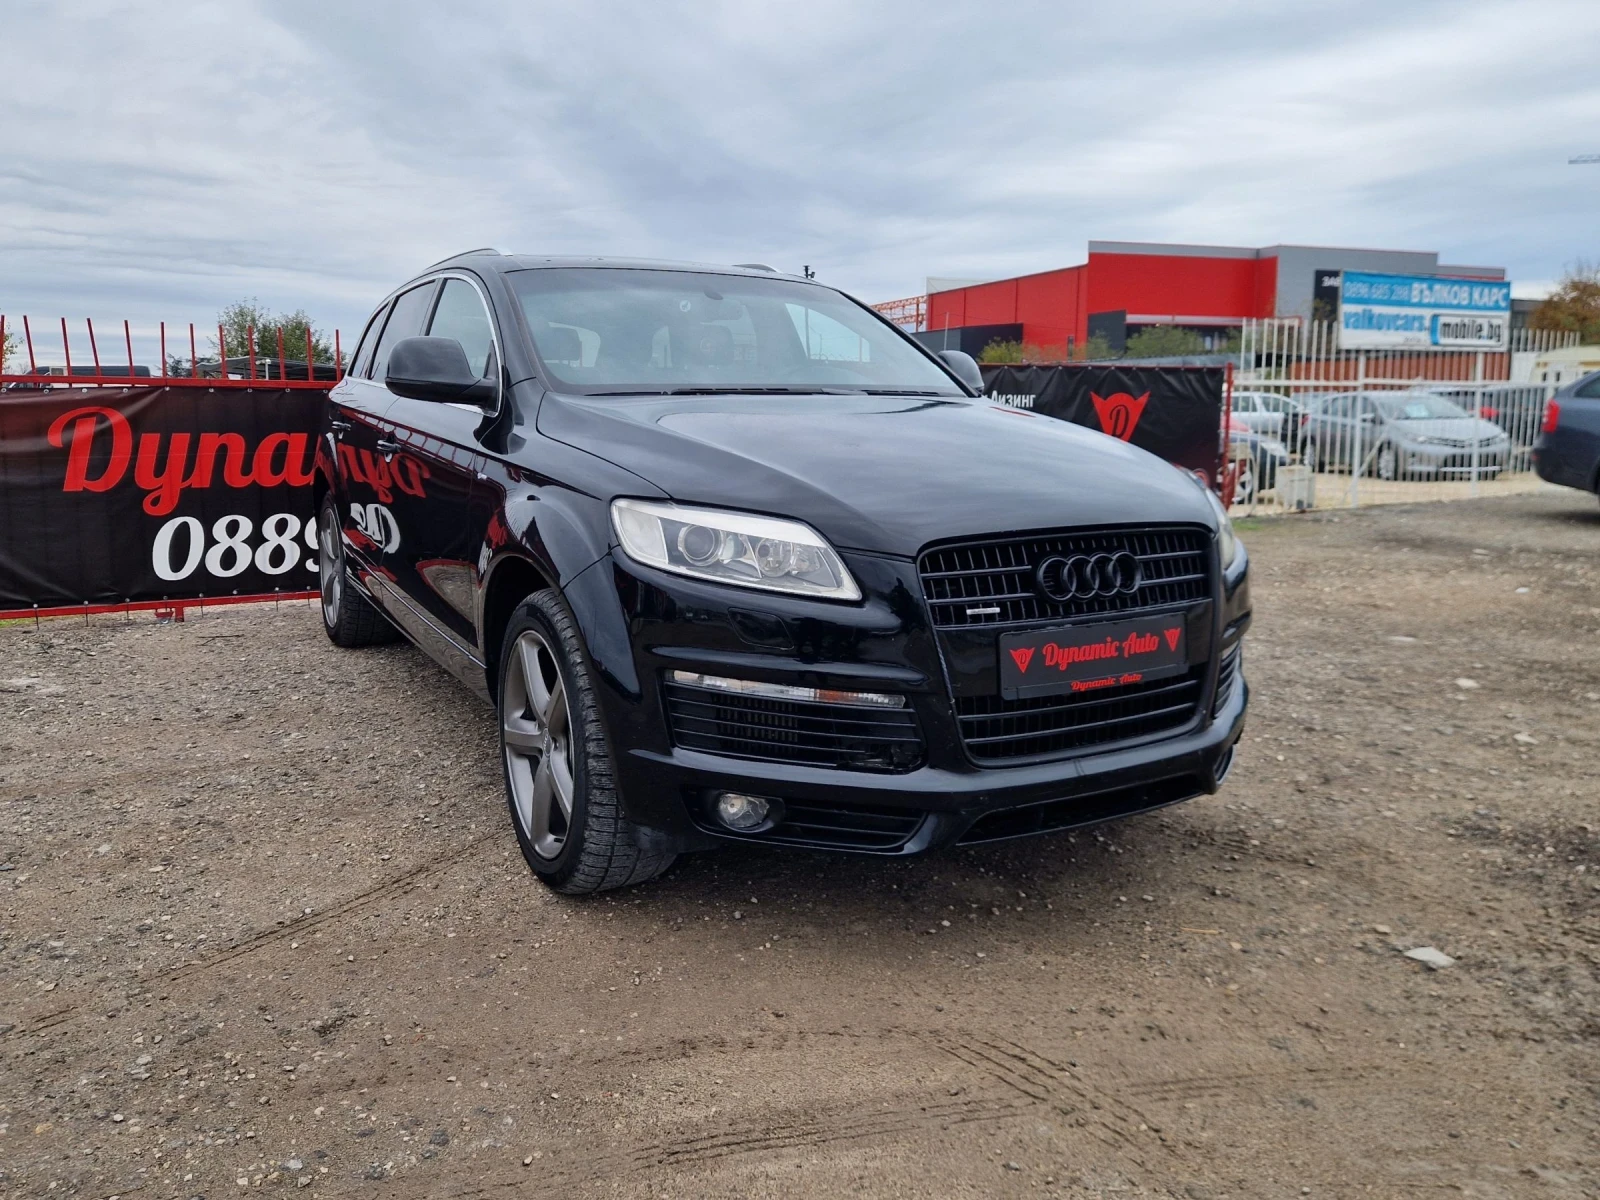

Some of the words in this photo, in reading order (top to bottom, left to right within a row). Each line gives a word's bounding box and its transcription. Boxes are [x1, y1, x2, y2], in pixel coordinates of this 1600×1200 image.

[1472, 285, 1508, 307] КАРС
[47, 406, 322, 516] Dyna
[1042, 636, 1119, 671] Dynamic
[1122, 631, 1160, 658] Auto
[1070, 676, 1116, 692] Dynamic
[1119, 673, 1143, 684] Auto
